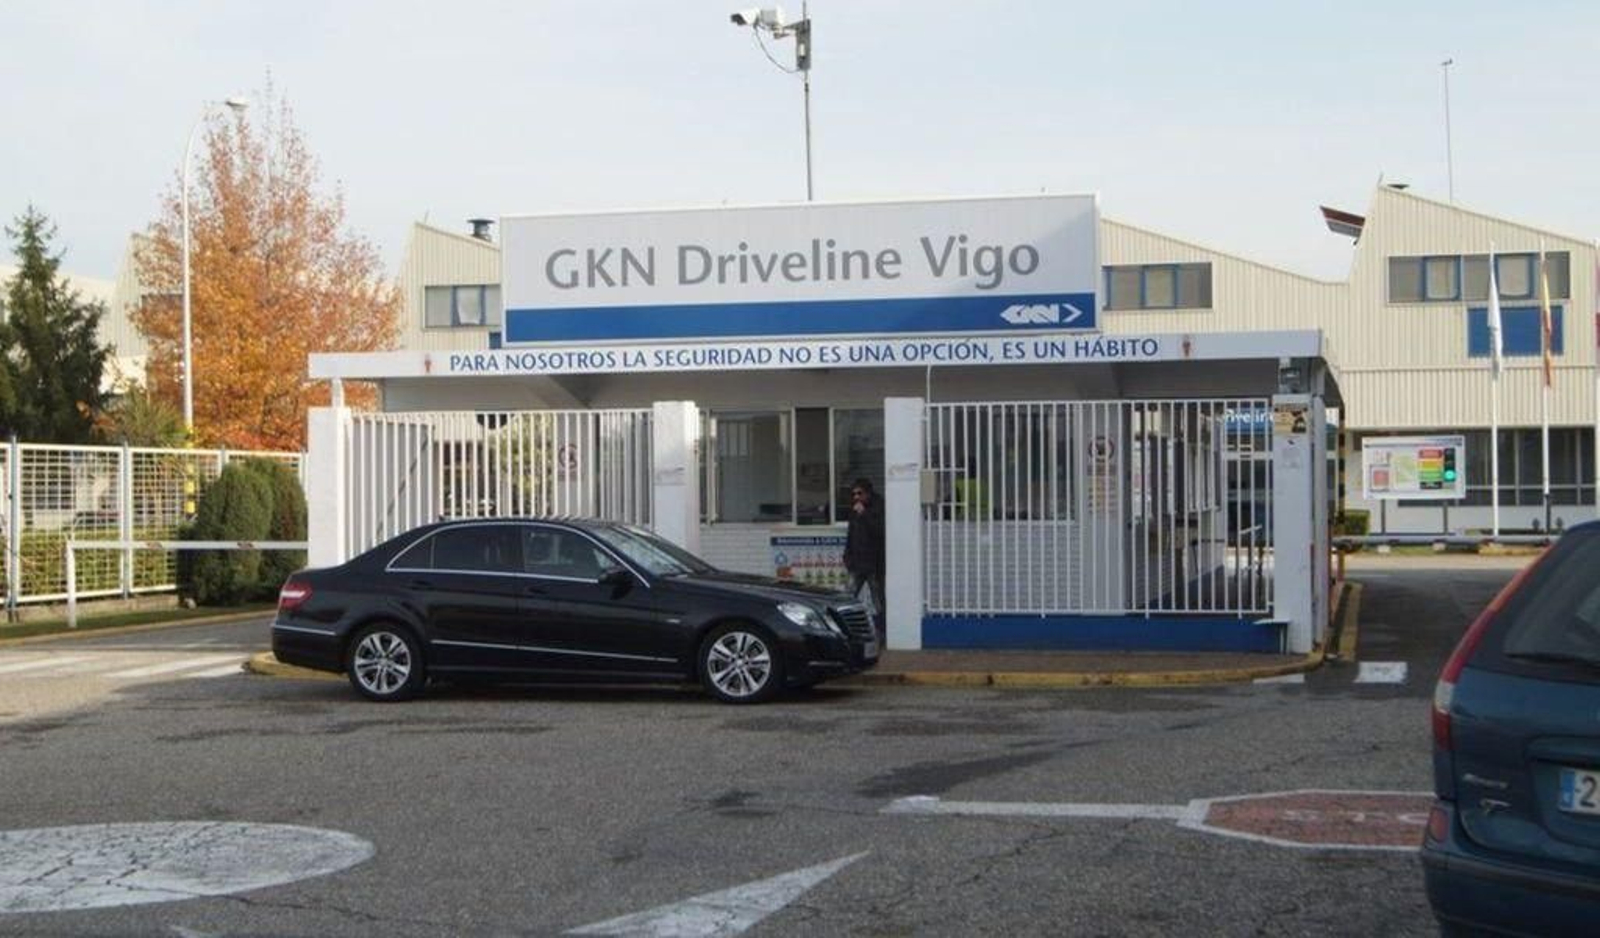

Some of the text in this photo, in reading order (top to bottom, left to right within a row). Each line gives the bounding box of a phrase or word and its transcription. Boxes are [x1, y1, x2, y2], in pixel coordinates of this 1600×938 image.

[545, 233, 1040, 290] GKN Driveline Vigo
[450, 335, 1158, 371] PARA NOSOTROS LA SEGURIDAD NO ES UNA OPCIÓN, ES UN HÁBITO
